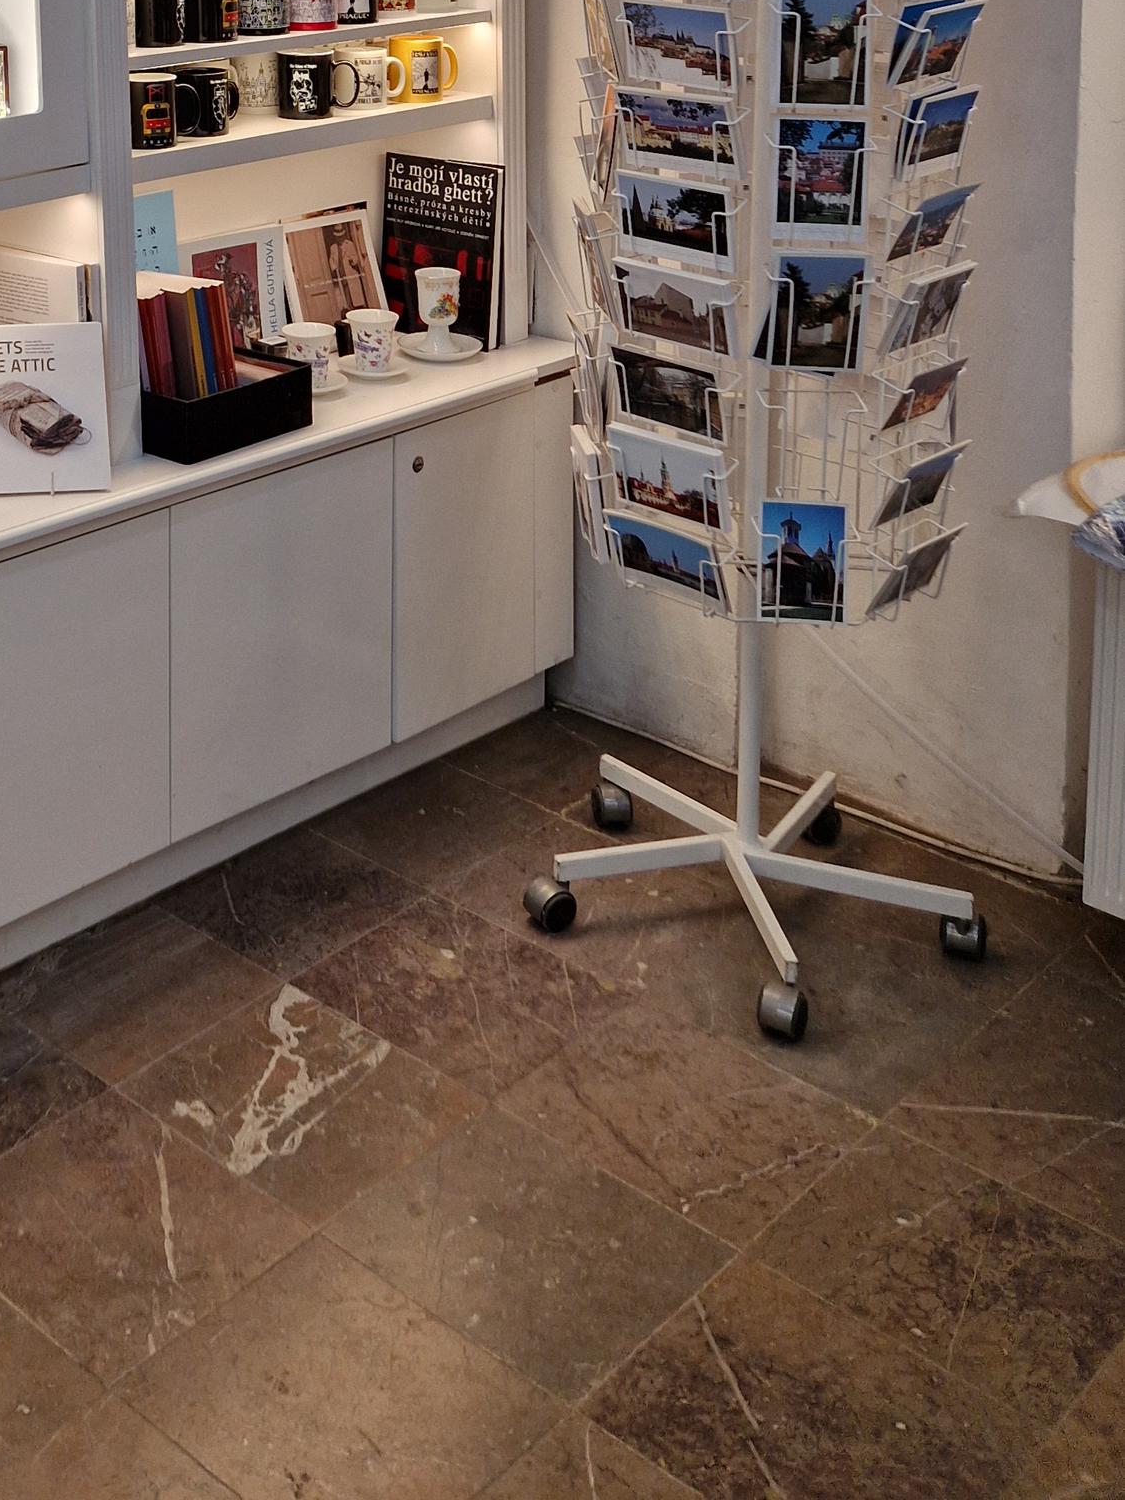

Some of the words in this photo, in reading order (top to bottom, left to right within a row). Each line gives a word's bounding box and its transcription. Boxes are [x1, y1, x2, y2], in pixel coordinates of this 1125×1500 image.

[388, 173, 440, 196] hradba
[443, 183, 483, 203] ghett
[389, 158, 405, 173] Je
[409, 165, 445, 183] mojí
[449, 169, 494, 189] vlastí
[388, 192, 417, 205] Básně,
[420, 199, 447, 210] próza
[458, 205, 491, 219] kresby
[394, 204, 459, 222] terezínských
[462, 216, 483, 227] dětí
[265, 238, 276, 296] GUTHOVÁ
[268, 299, 278, 333] HELLA
[11, 357, 56, 373] ATTIC
